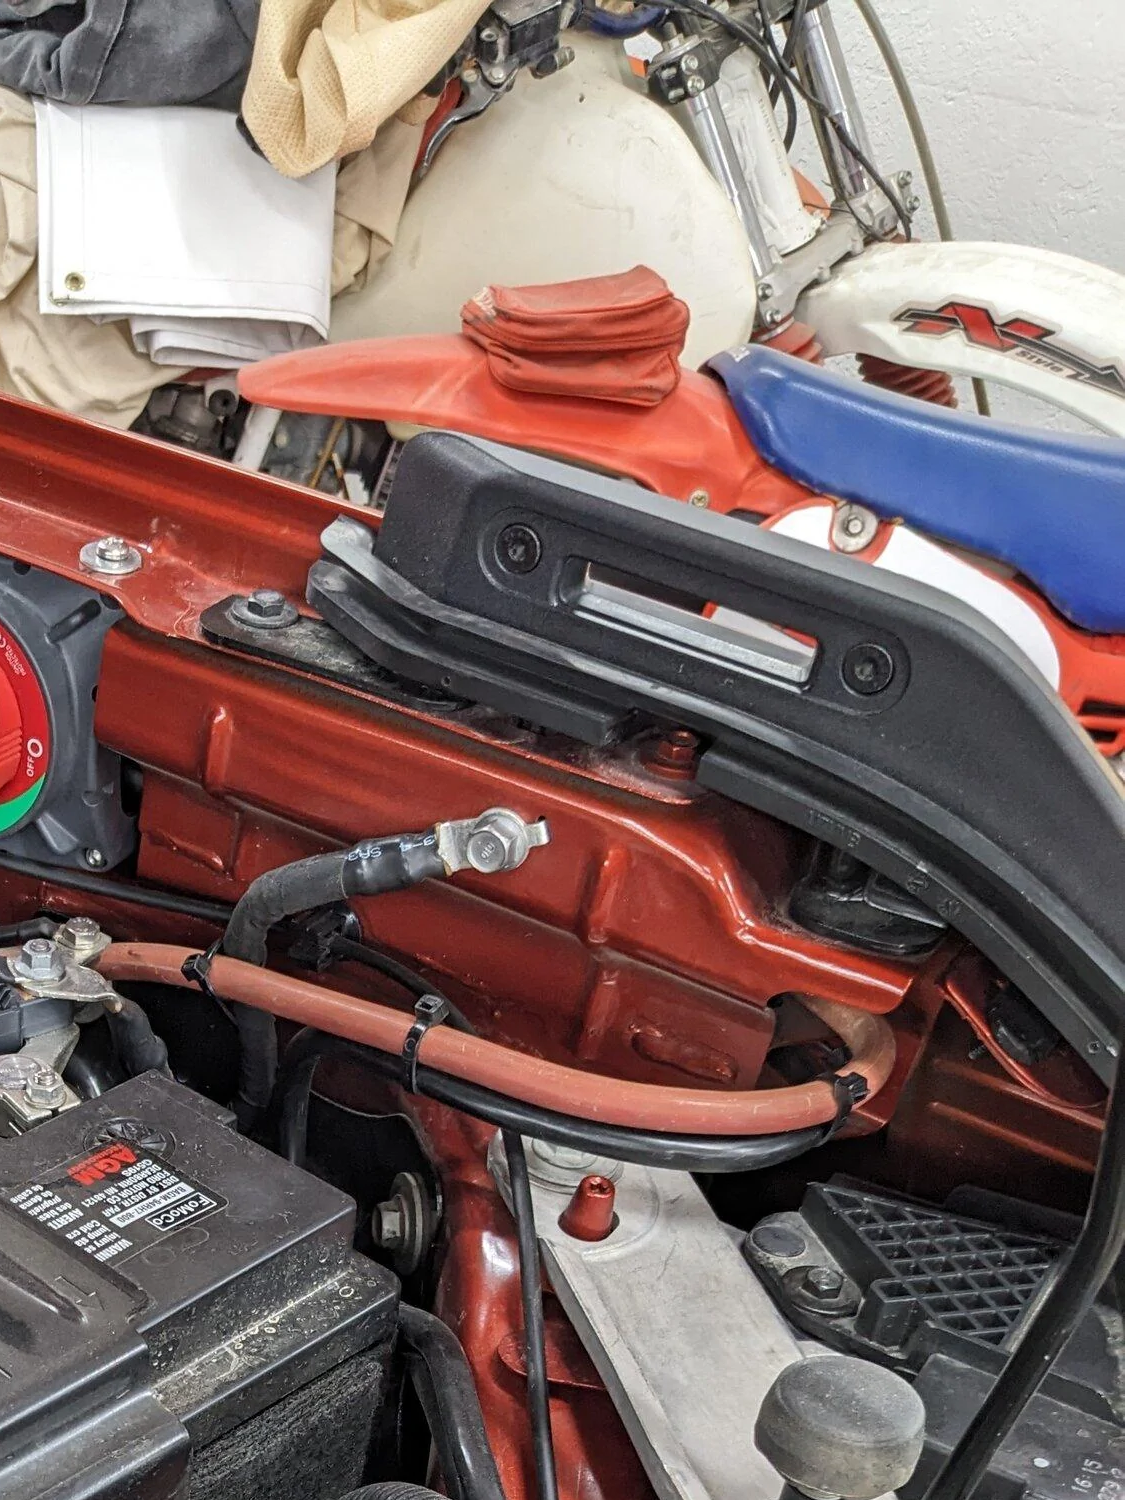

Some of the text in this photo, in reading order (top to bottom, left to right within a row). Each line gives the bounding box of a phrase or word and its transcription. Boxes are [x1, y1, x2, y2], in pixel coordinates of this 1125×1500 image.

[26, 756, 35, 778] OFF
[70, 1144, 137, 1185] AGM
[113, 1163, 162, 1189] DEARBORN,
[144, 1169, 171, 1184] FORD
[103, 1186, 118, 1195] MI
[116, 1180, 149, 1198] MOTOR
[143, 1185, 160, 1194] BY
[45, 1207, 85, 1230] AVERTI
[99, 1204, 122, 1217] PAR
[151, 1196, 210, 1227] FoMoCo
[77, 1219, 101, 1233] Cold
